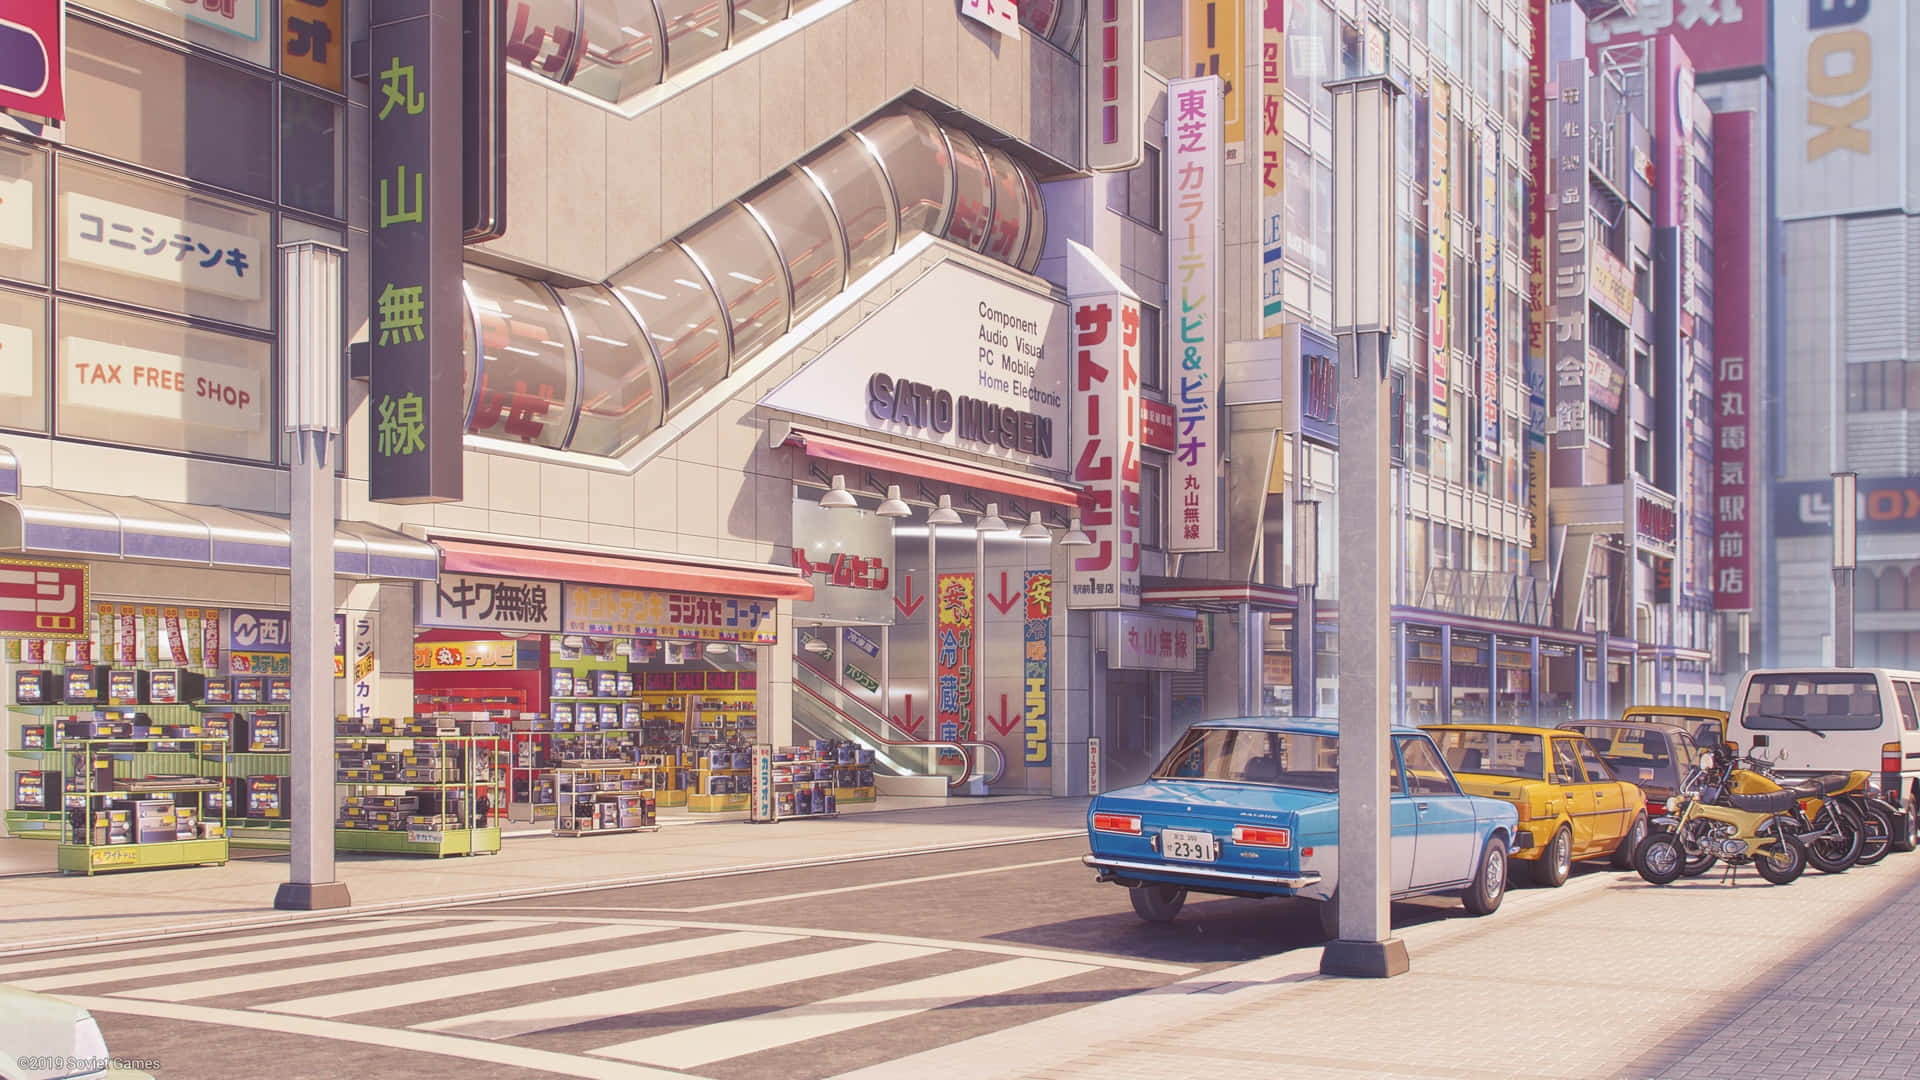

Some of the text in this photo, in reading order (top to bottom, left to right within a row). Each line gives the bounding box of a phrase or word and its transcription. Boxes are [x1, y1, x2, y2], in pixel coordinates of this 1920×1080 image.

[79, 212, 250, 278] コニシテンキ
[378, 56, 426, 457] 丸山無線
[977, 300, 1038, 336] Component
[1176, 88, 1209, 541] 東芝 カラーテレビ&ビデオ 丸山無線
[978, 325, 1045, 361] Audio Visual
[978, 346, 1035, 379] PC Mobile
[75, 362, 251, 410] TAX FREE SHOP
[978, 369, 1062, 409] Home Electronic
[866, 372, 1053, 459] SATO MUSEN
[1075, 303, 1113, 573] サトームセン
[792, 547, 889, 590] トームセン
[436, 578, 548, 624] トキワ無線
[669, 594, 722, 627] ラジカセ
[726, 599, 771, 628] コーナー
[943, 580, 970, 624] 安い
[708, 673, 734, 690] SALE
[739, 673, 757, 690] SA
[940, 629, 960, 762] 冷蔵庫
